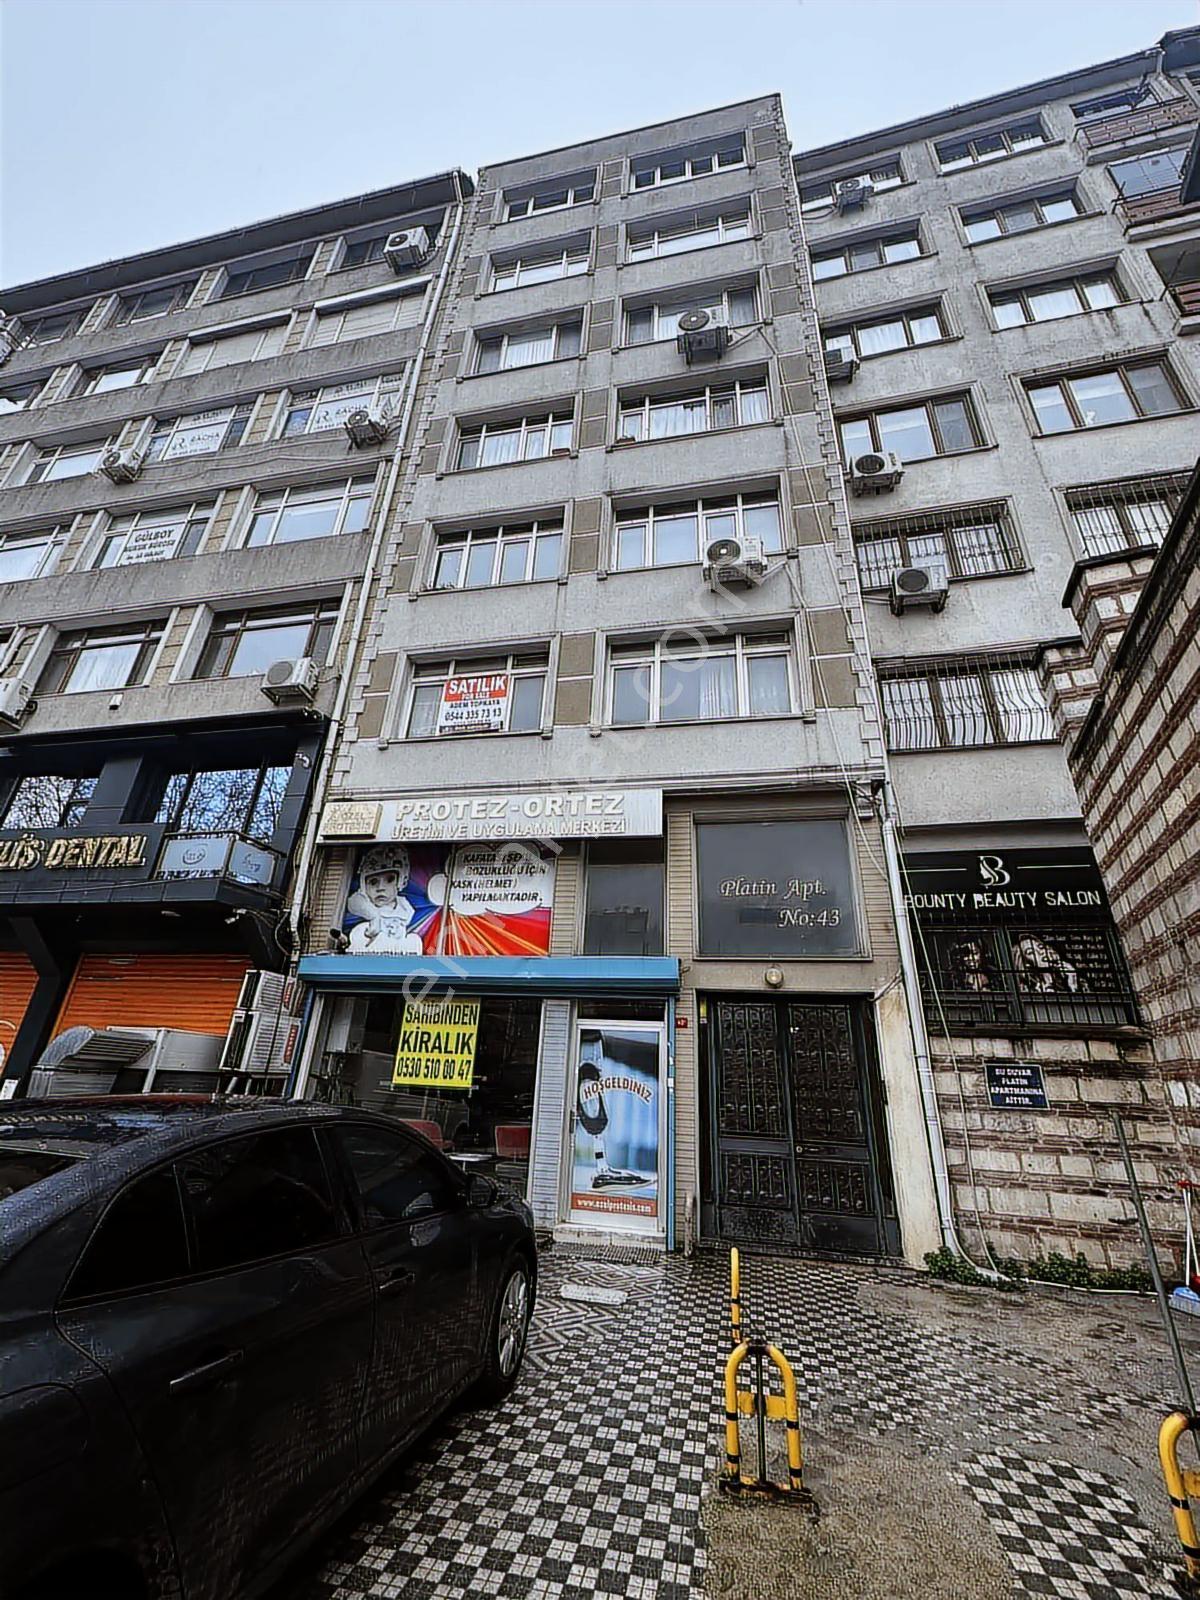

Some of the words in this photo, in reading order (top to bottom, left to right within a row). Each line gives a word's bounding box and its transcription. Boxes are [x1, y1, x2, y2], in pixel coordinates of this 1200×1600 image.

[448, 676, 507, 695] SATILIK
[396, 794, 625, 821] PROTEZ-ORTEZ
[391, 822, 444, 840] ÜRETİM
[447, 823, 468, 838] VE
[472, 820, 557, 838] UYGULAMA
[45, 835, 147, 868] DENTAL
[720, 877, 777, 897] Platin
[783, 878, 827, 901] Apt.
[904, 893, 967, 909] BOUNTY
[973, 891, 1037, 909] BEAUTY
[1045, 890, 1101, 906] SALON
[778, 908, 840, 928] No:43
[401, 1026, 474, 1055] KİRALIK
[396, 1057, 421, 1077] 0530
[424, 1058, 440, 1079] 510
[458, 1059, 472, 1081] 47
